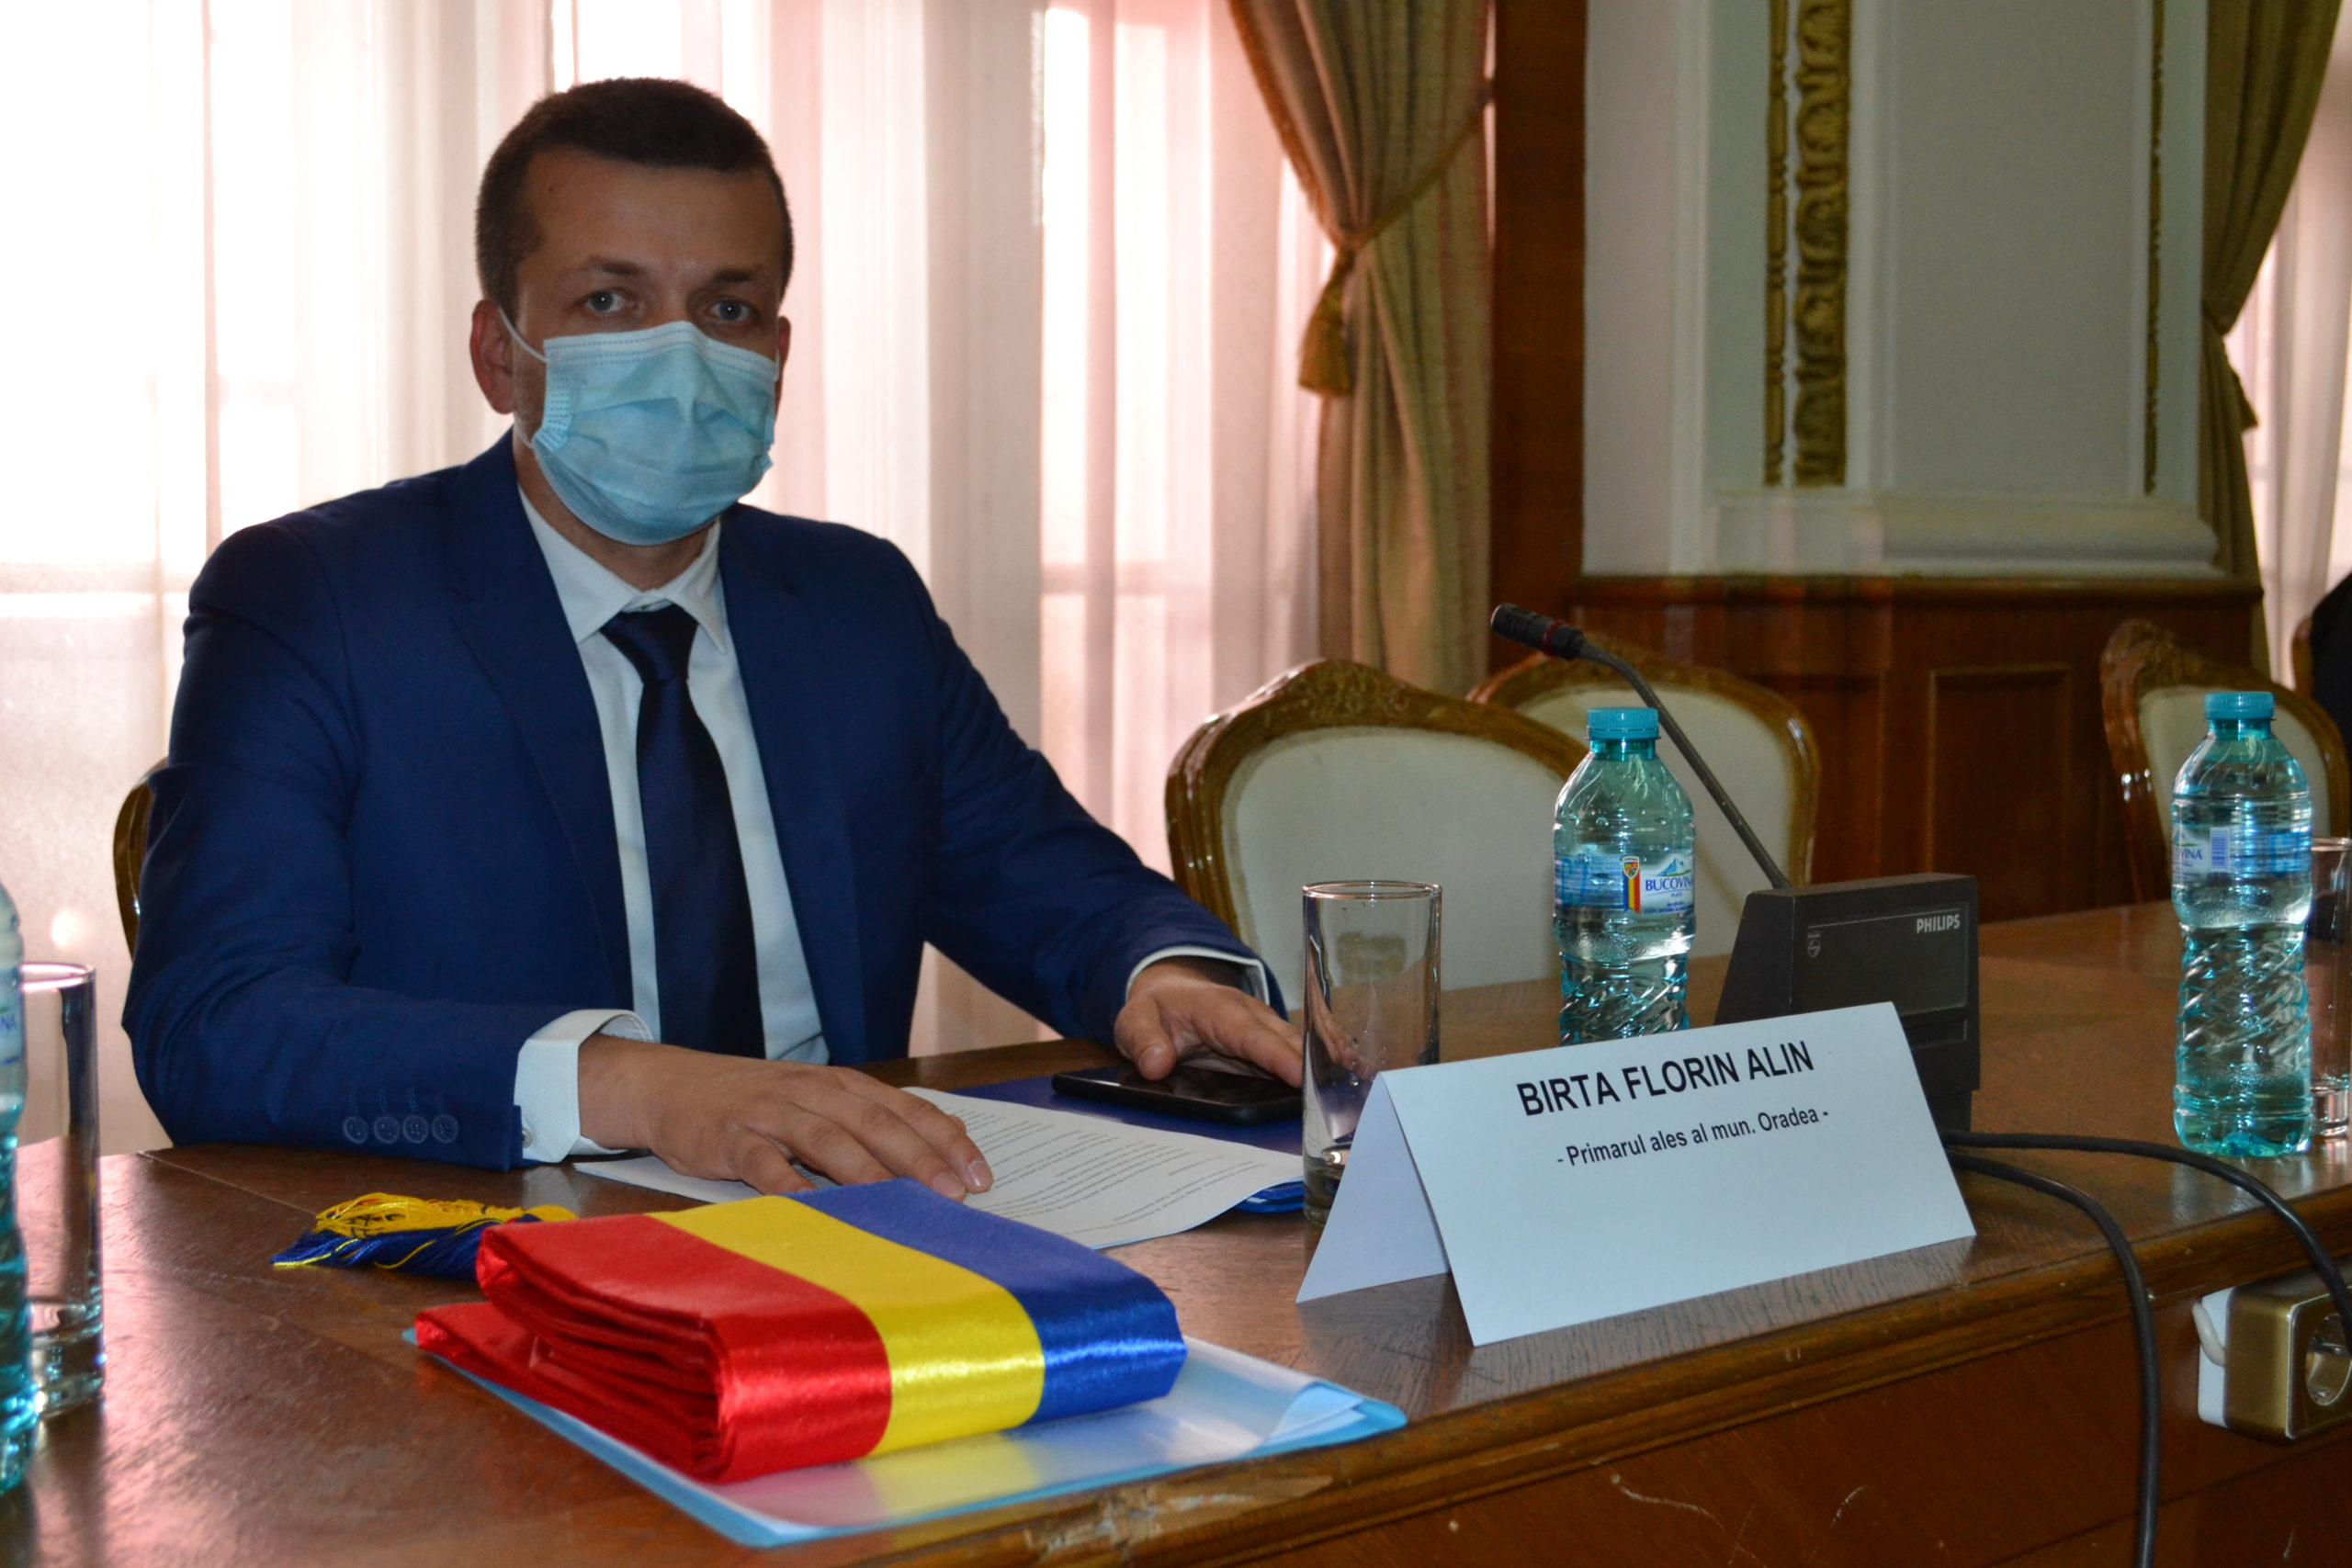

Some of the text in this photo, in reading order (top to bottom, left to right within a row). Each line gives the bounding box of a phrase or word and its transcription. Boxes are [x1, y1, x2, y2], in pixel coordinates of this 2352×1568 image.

[1645, 875, 1691, 891] BUCOVIN
[1917, 914, 1961, 934] PHILIPS
[1517, 1041, 1815, 1116] BIRTA FLORIN ALIN
[1566, 1134, 1646, 1166] Primarul
[1650, 1131, 1687, 1151] ales
[1692, 1123, 1707, 1145] al
[1711, 1120, 1756, 1140] mun.
[1758, 1107, 1819, 1132] Oradea
